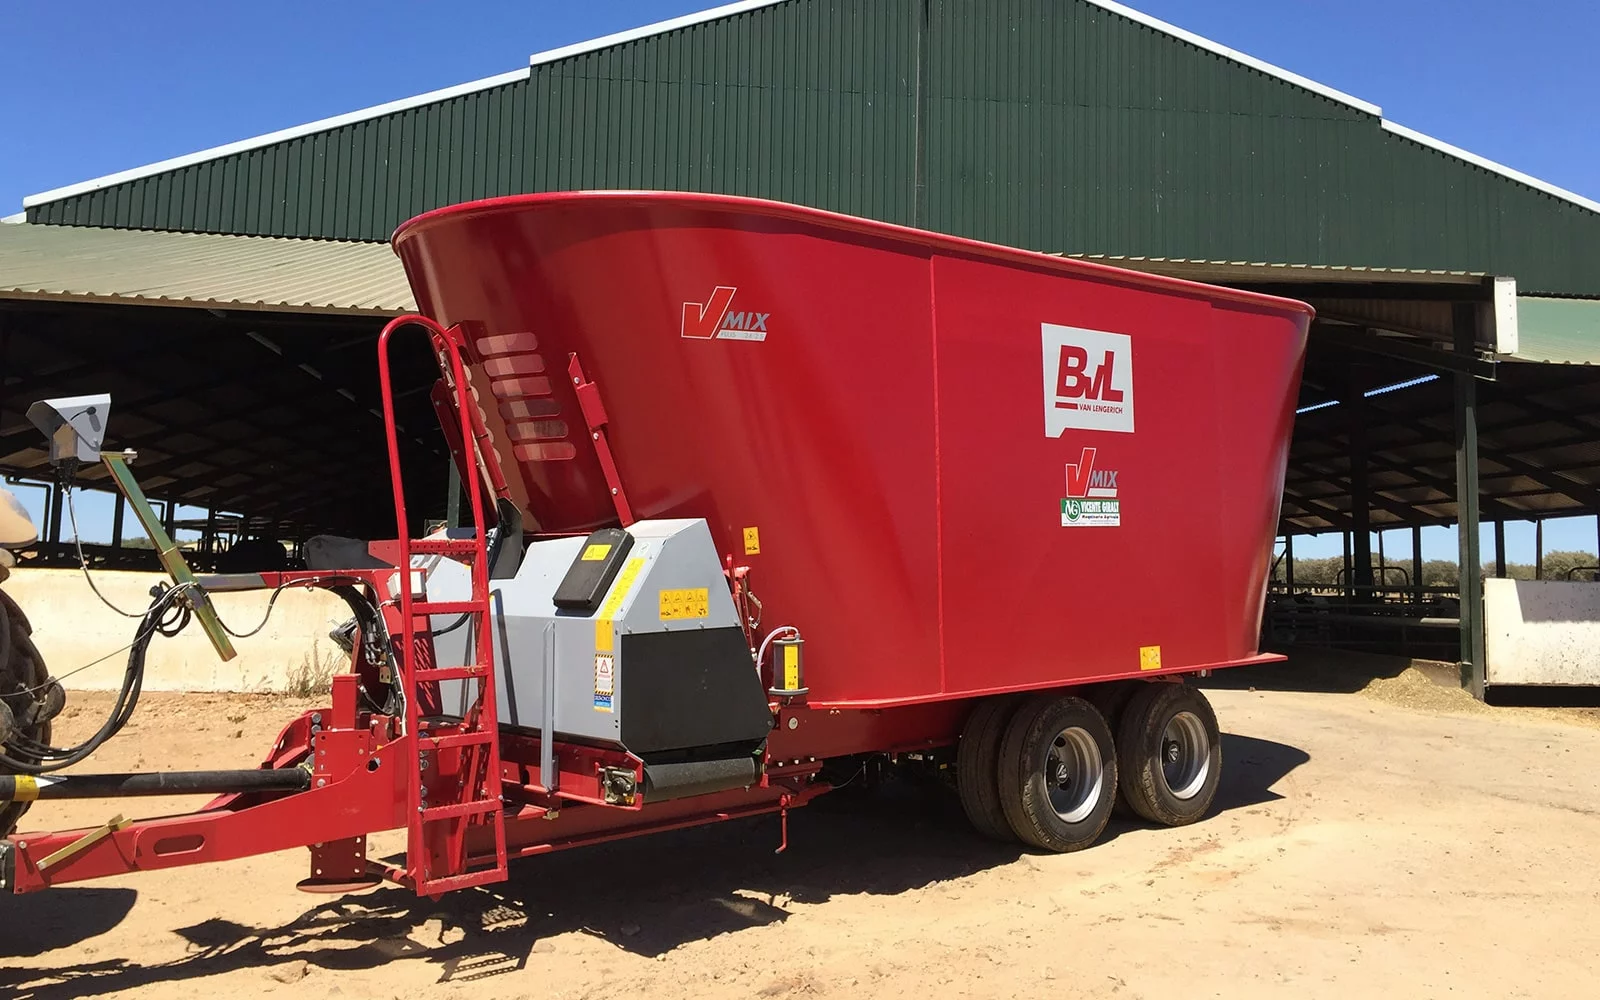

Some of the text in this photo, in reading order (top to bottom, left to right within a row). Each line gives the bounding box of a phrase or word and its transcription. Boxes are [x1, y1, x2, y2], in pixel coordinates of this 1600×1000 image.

[722, 311, 770, 331] MIX
[1079, 403, 1123, 414] VAN LENGERICH
[1090, 470, 1118, 488] MIX
[1080, 501, 1102, 513] VICENTE
